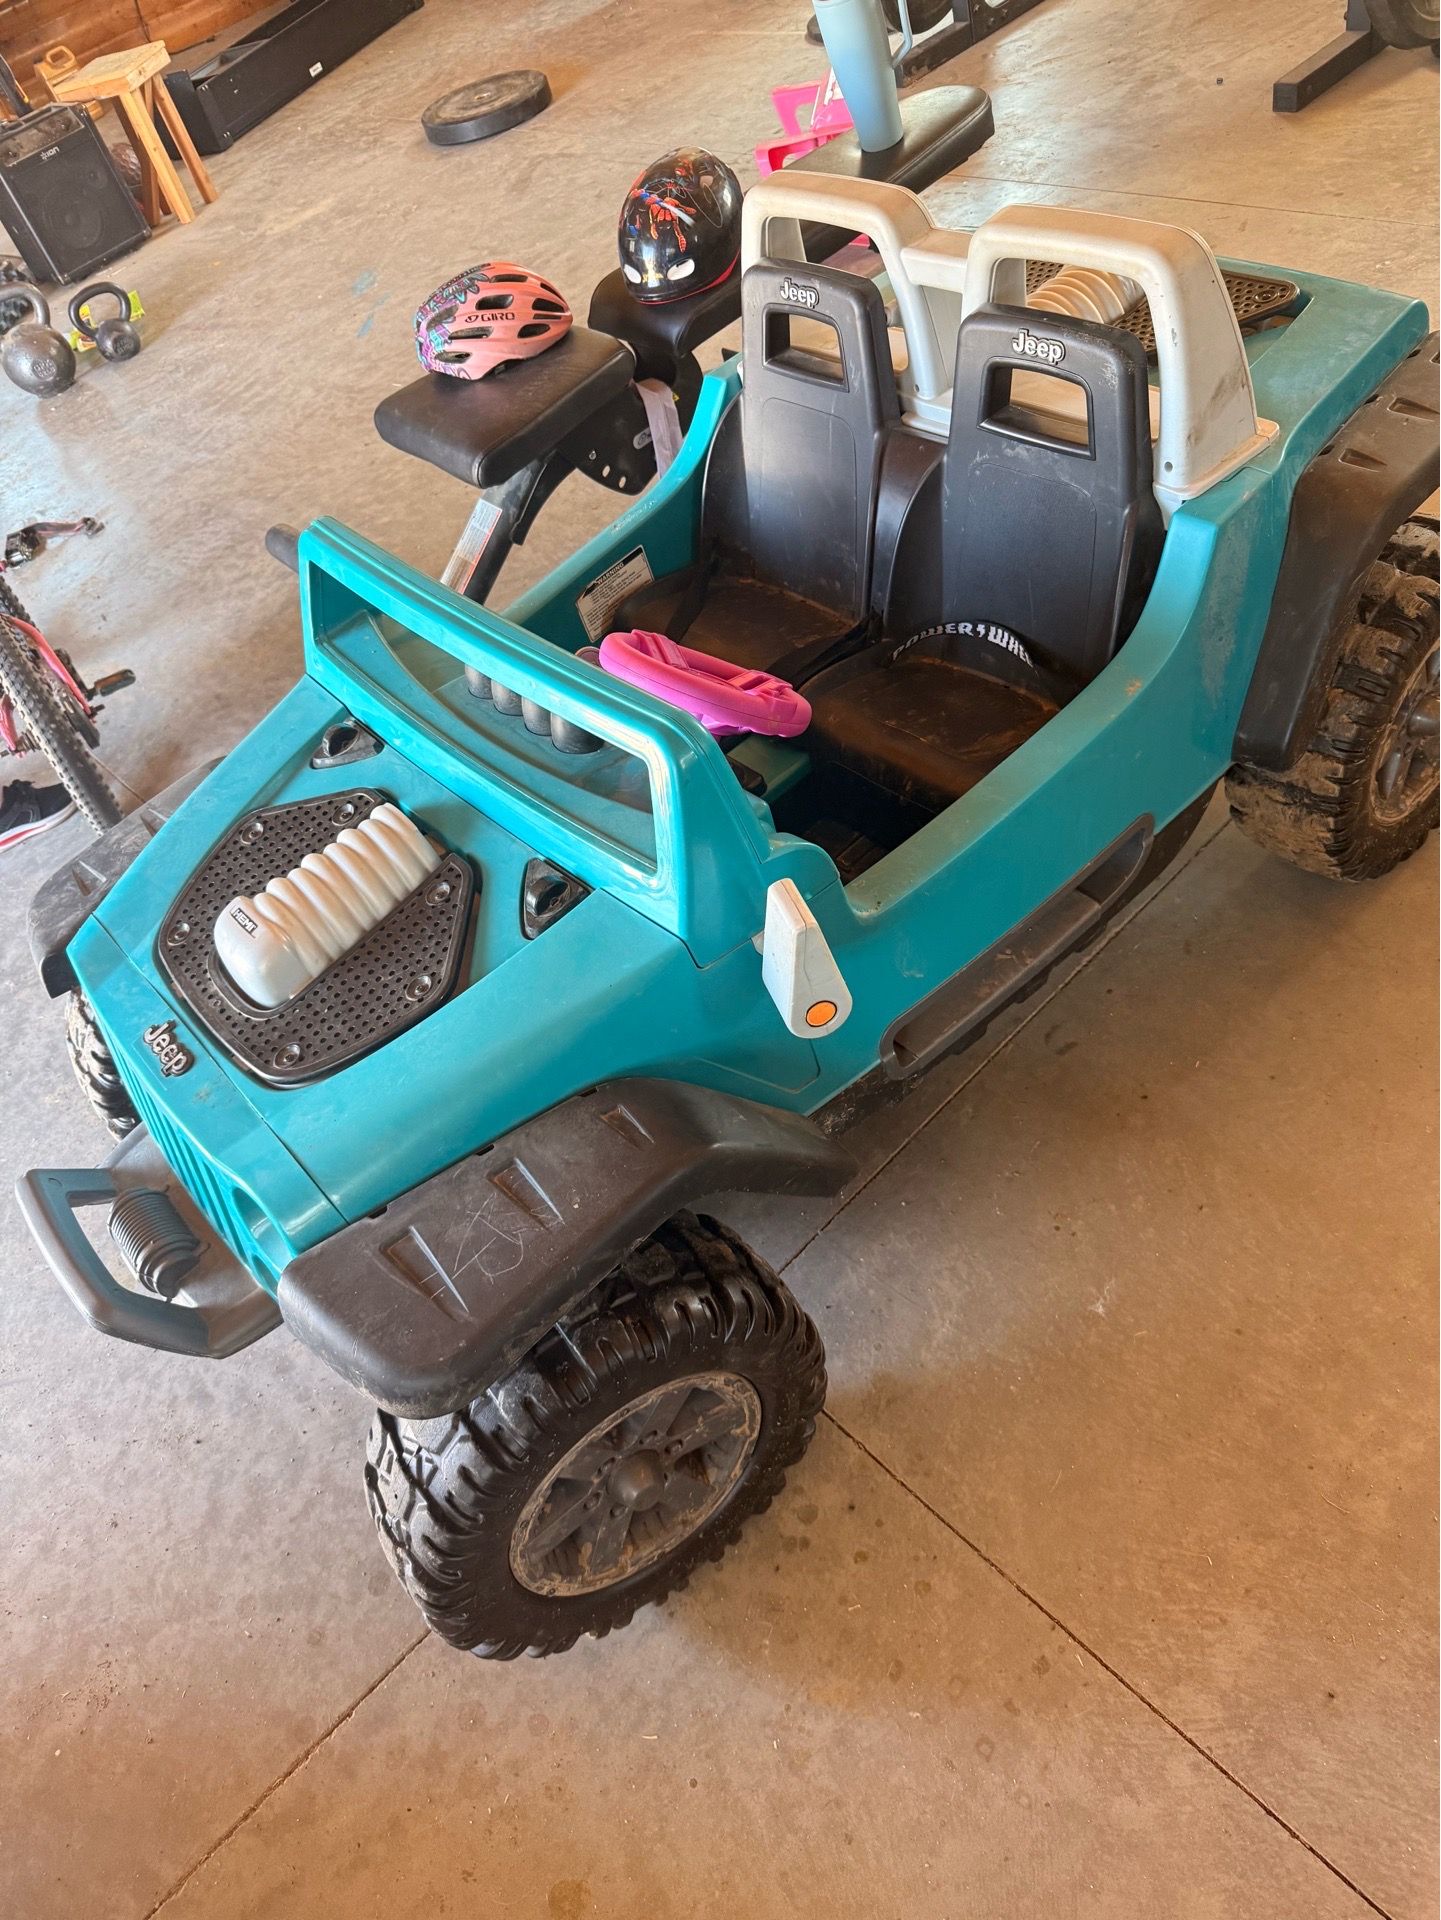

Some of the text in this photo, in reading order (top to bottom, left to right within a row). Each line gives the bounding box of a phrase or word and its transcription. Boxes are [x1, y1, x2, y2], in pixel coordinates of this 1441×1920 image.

[780, 277, 819, 309] Jeep
[481, 312, 515, 322] GIRO
[1012, 328, 1066, 365] Jeep
[597, 562, 625, 585] WARNING
[893, 622, 974, 661] POWER
[231, 908, 258, 933] HEMI
[144, 1021, 191, 1075] Jeep
